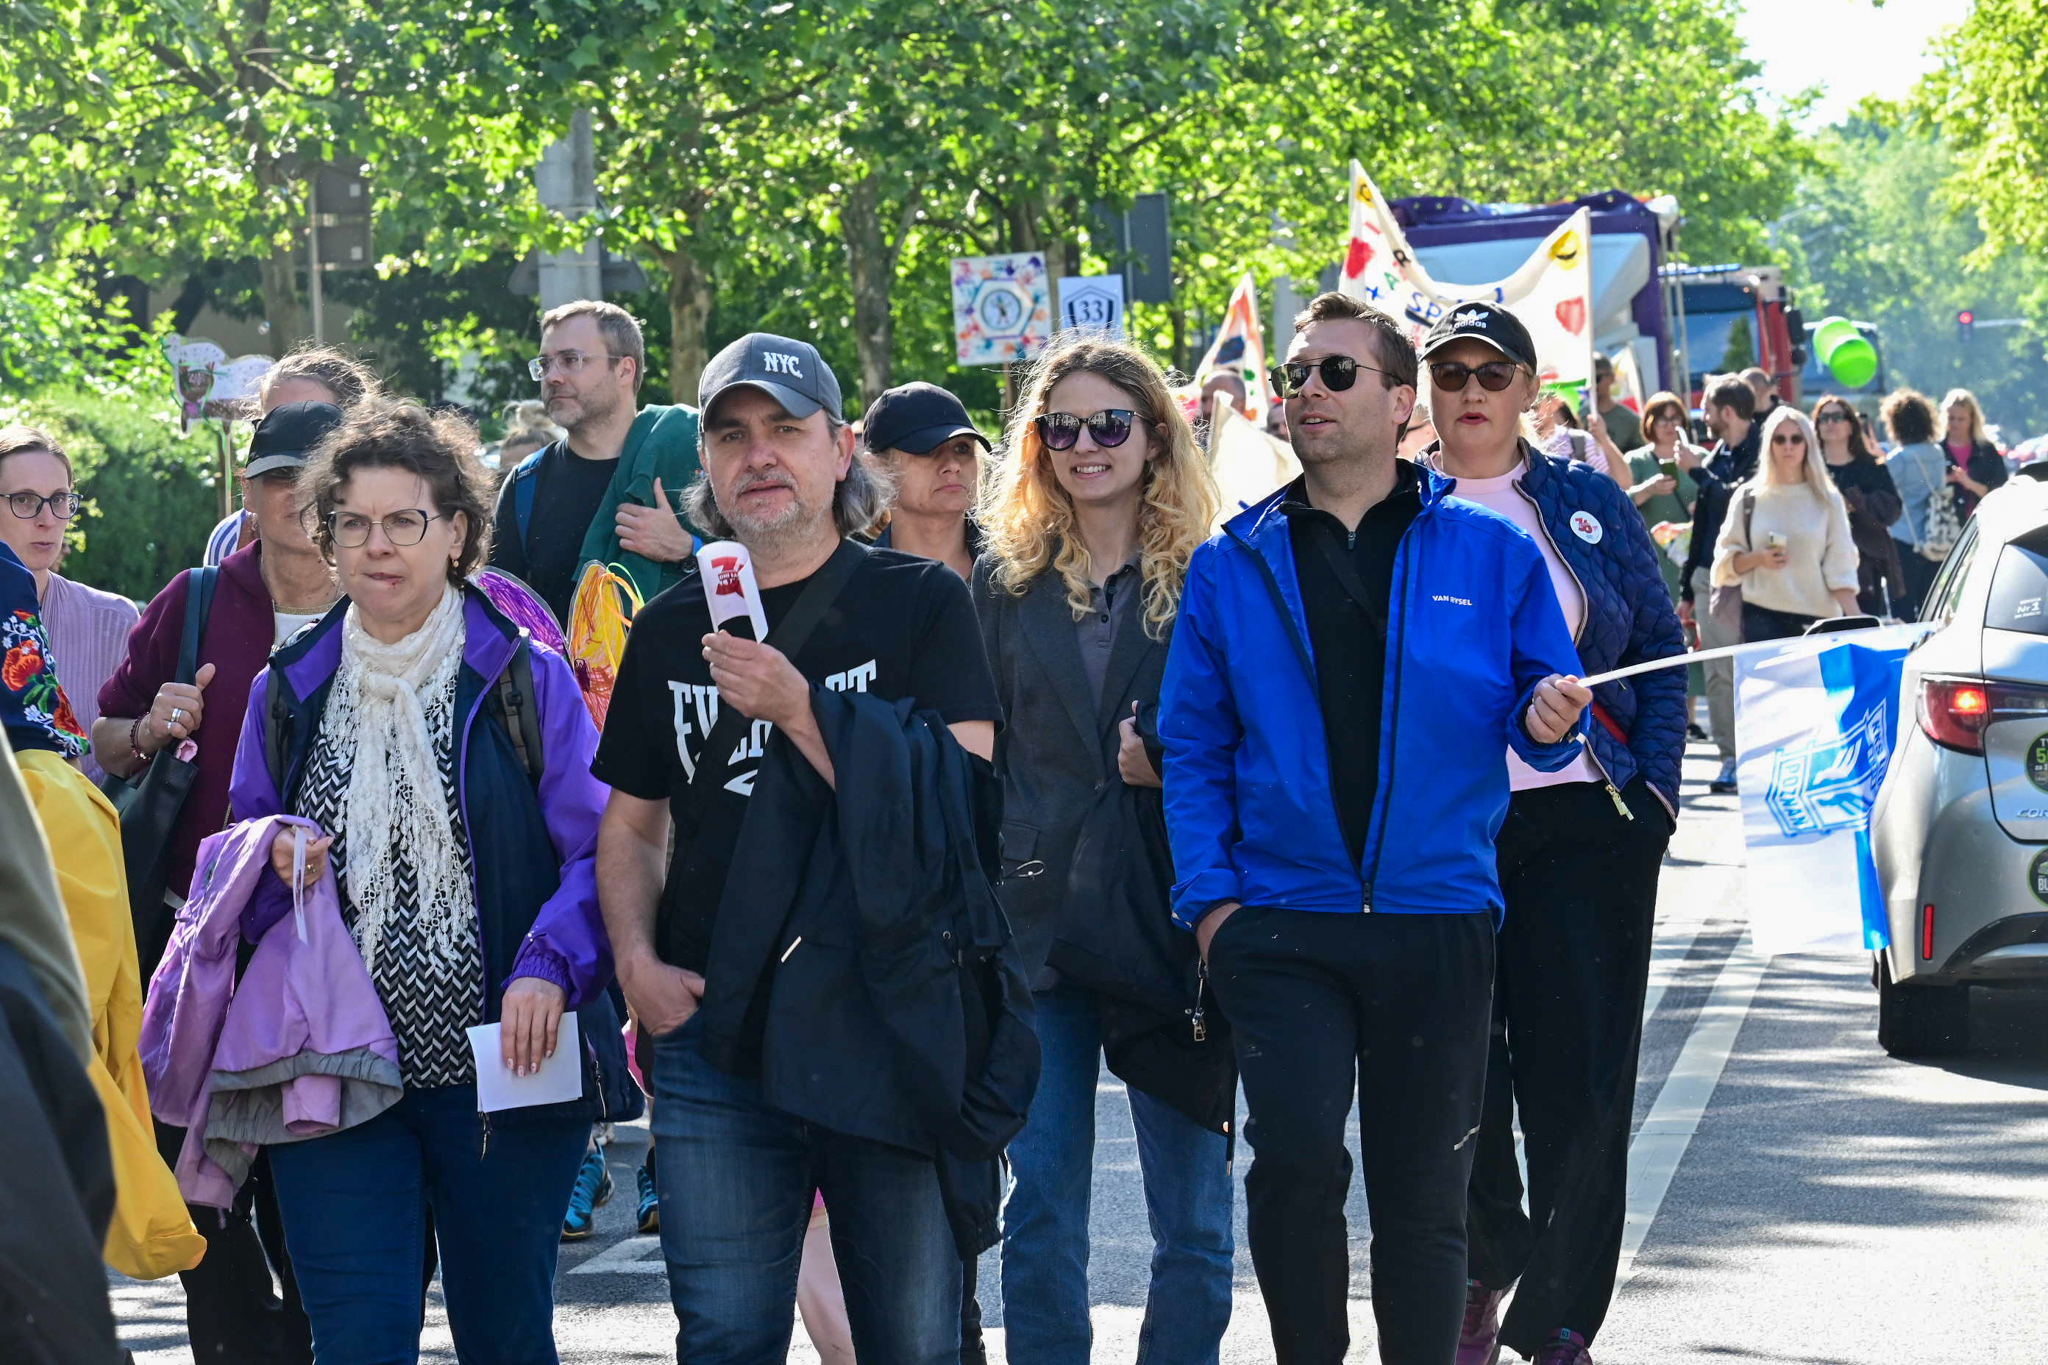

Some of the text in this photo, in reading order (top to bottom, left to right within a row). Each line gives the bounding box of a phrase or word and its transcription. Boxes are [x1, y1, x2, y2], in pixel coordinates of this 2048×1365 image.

[1453, 319, 1487, 330] adidas
[763, 351, 803, 379] NYC
[1450, 596, 1473, 606] RYSEL
